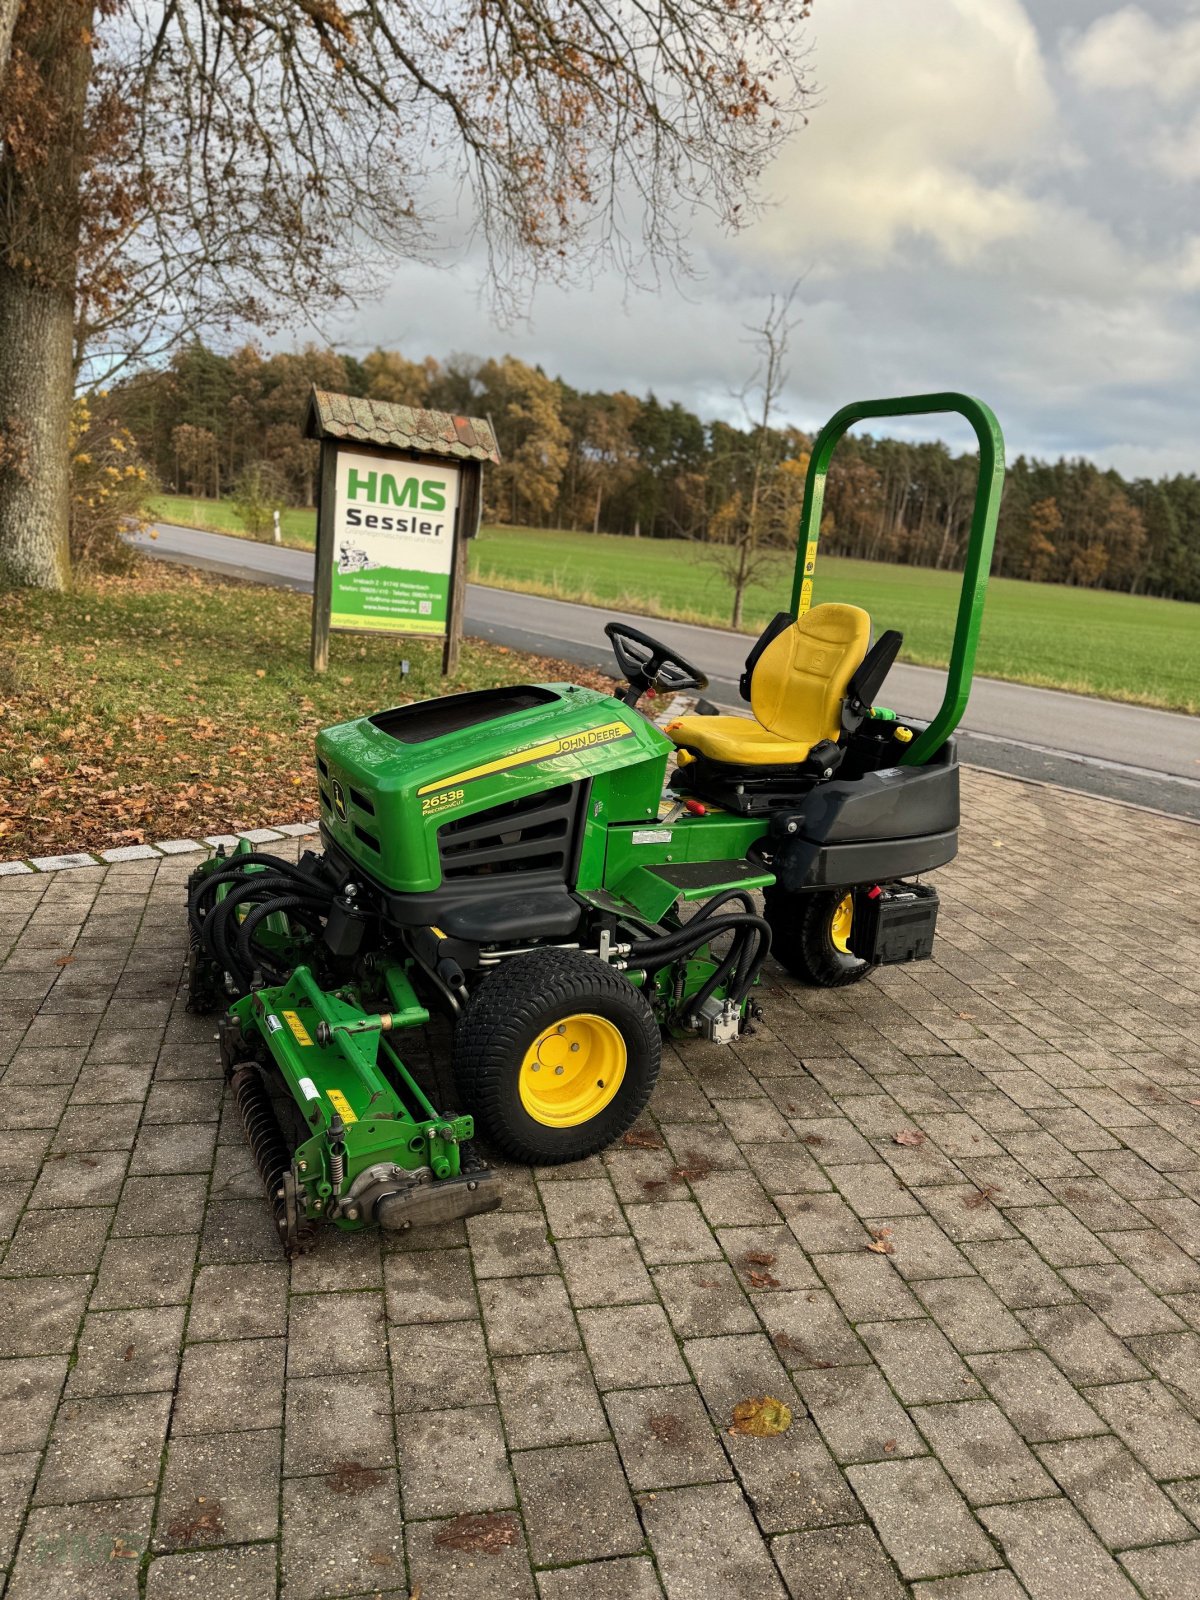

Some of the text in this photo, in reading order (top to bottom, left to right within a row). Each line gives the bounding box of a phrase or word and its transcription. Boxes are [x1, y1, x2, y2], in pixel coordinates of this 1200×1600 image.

[347, 468, 446, 512] HMS
[346, 508, 444, 536] Sessler
[555, 727, 621, 754] JOHN DEERE
[422, 789, 465, 810] 2653B
